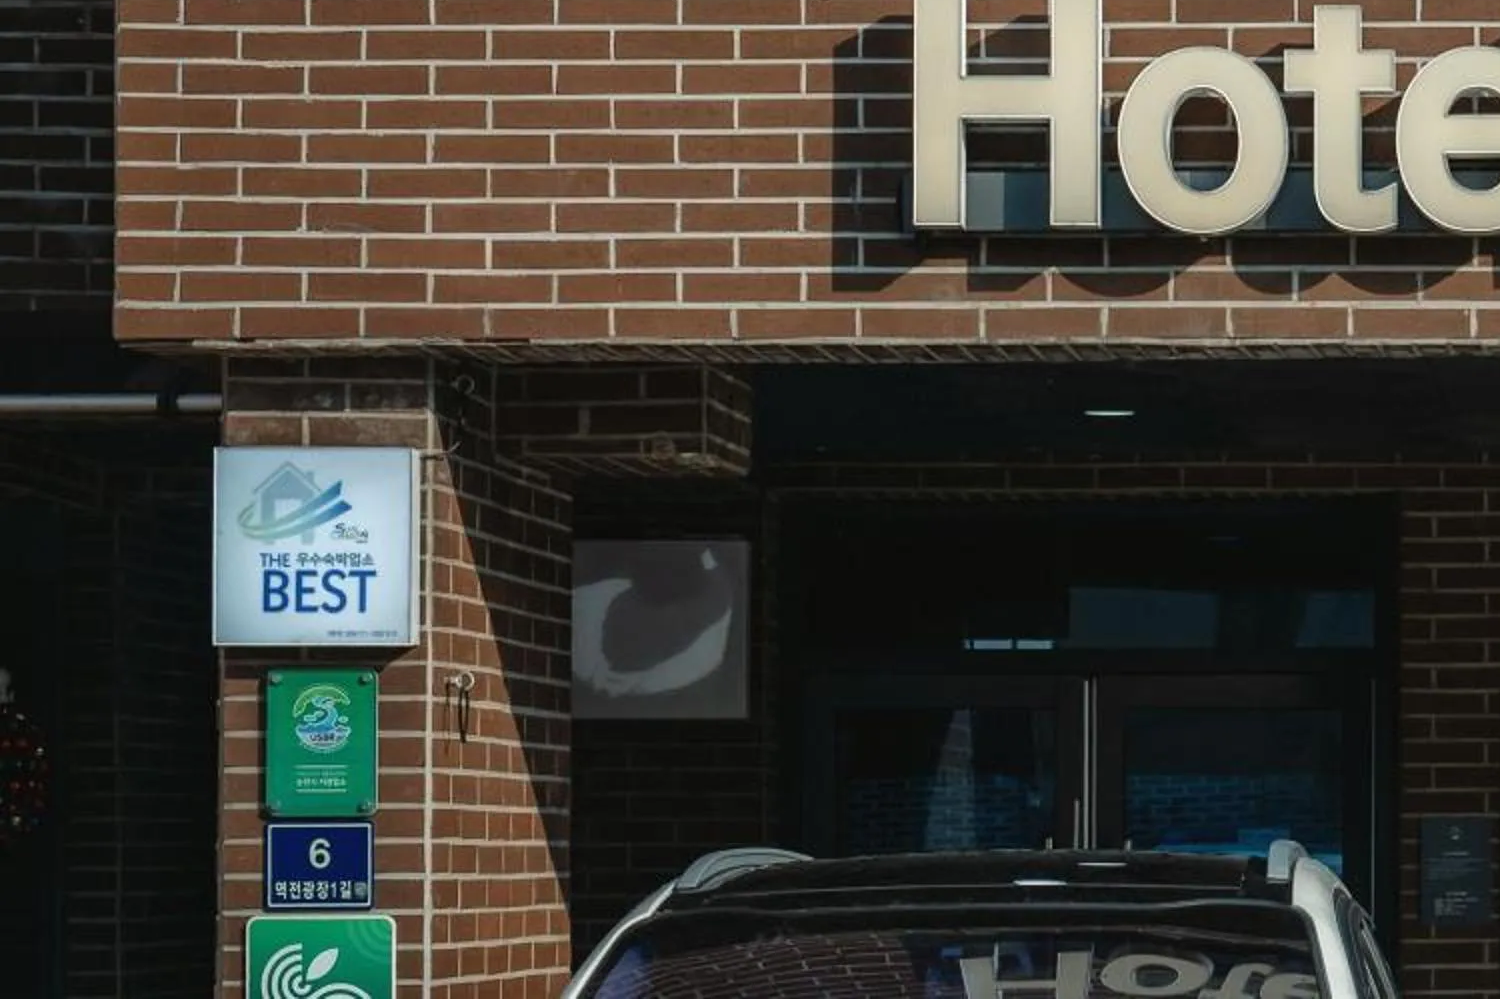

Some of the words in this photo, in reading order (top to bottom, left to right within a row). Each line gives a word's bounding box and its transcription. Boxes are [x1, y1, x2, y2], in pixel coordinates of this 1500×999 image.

[260, 552, 290, 568] THE
[296, 552, 375, 568] 우수숙박업소
[263, 569, 377, 613] BEST
[309, 838, 332, 869] 6
[275, 880, 352, 900] 역전광장1길
